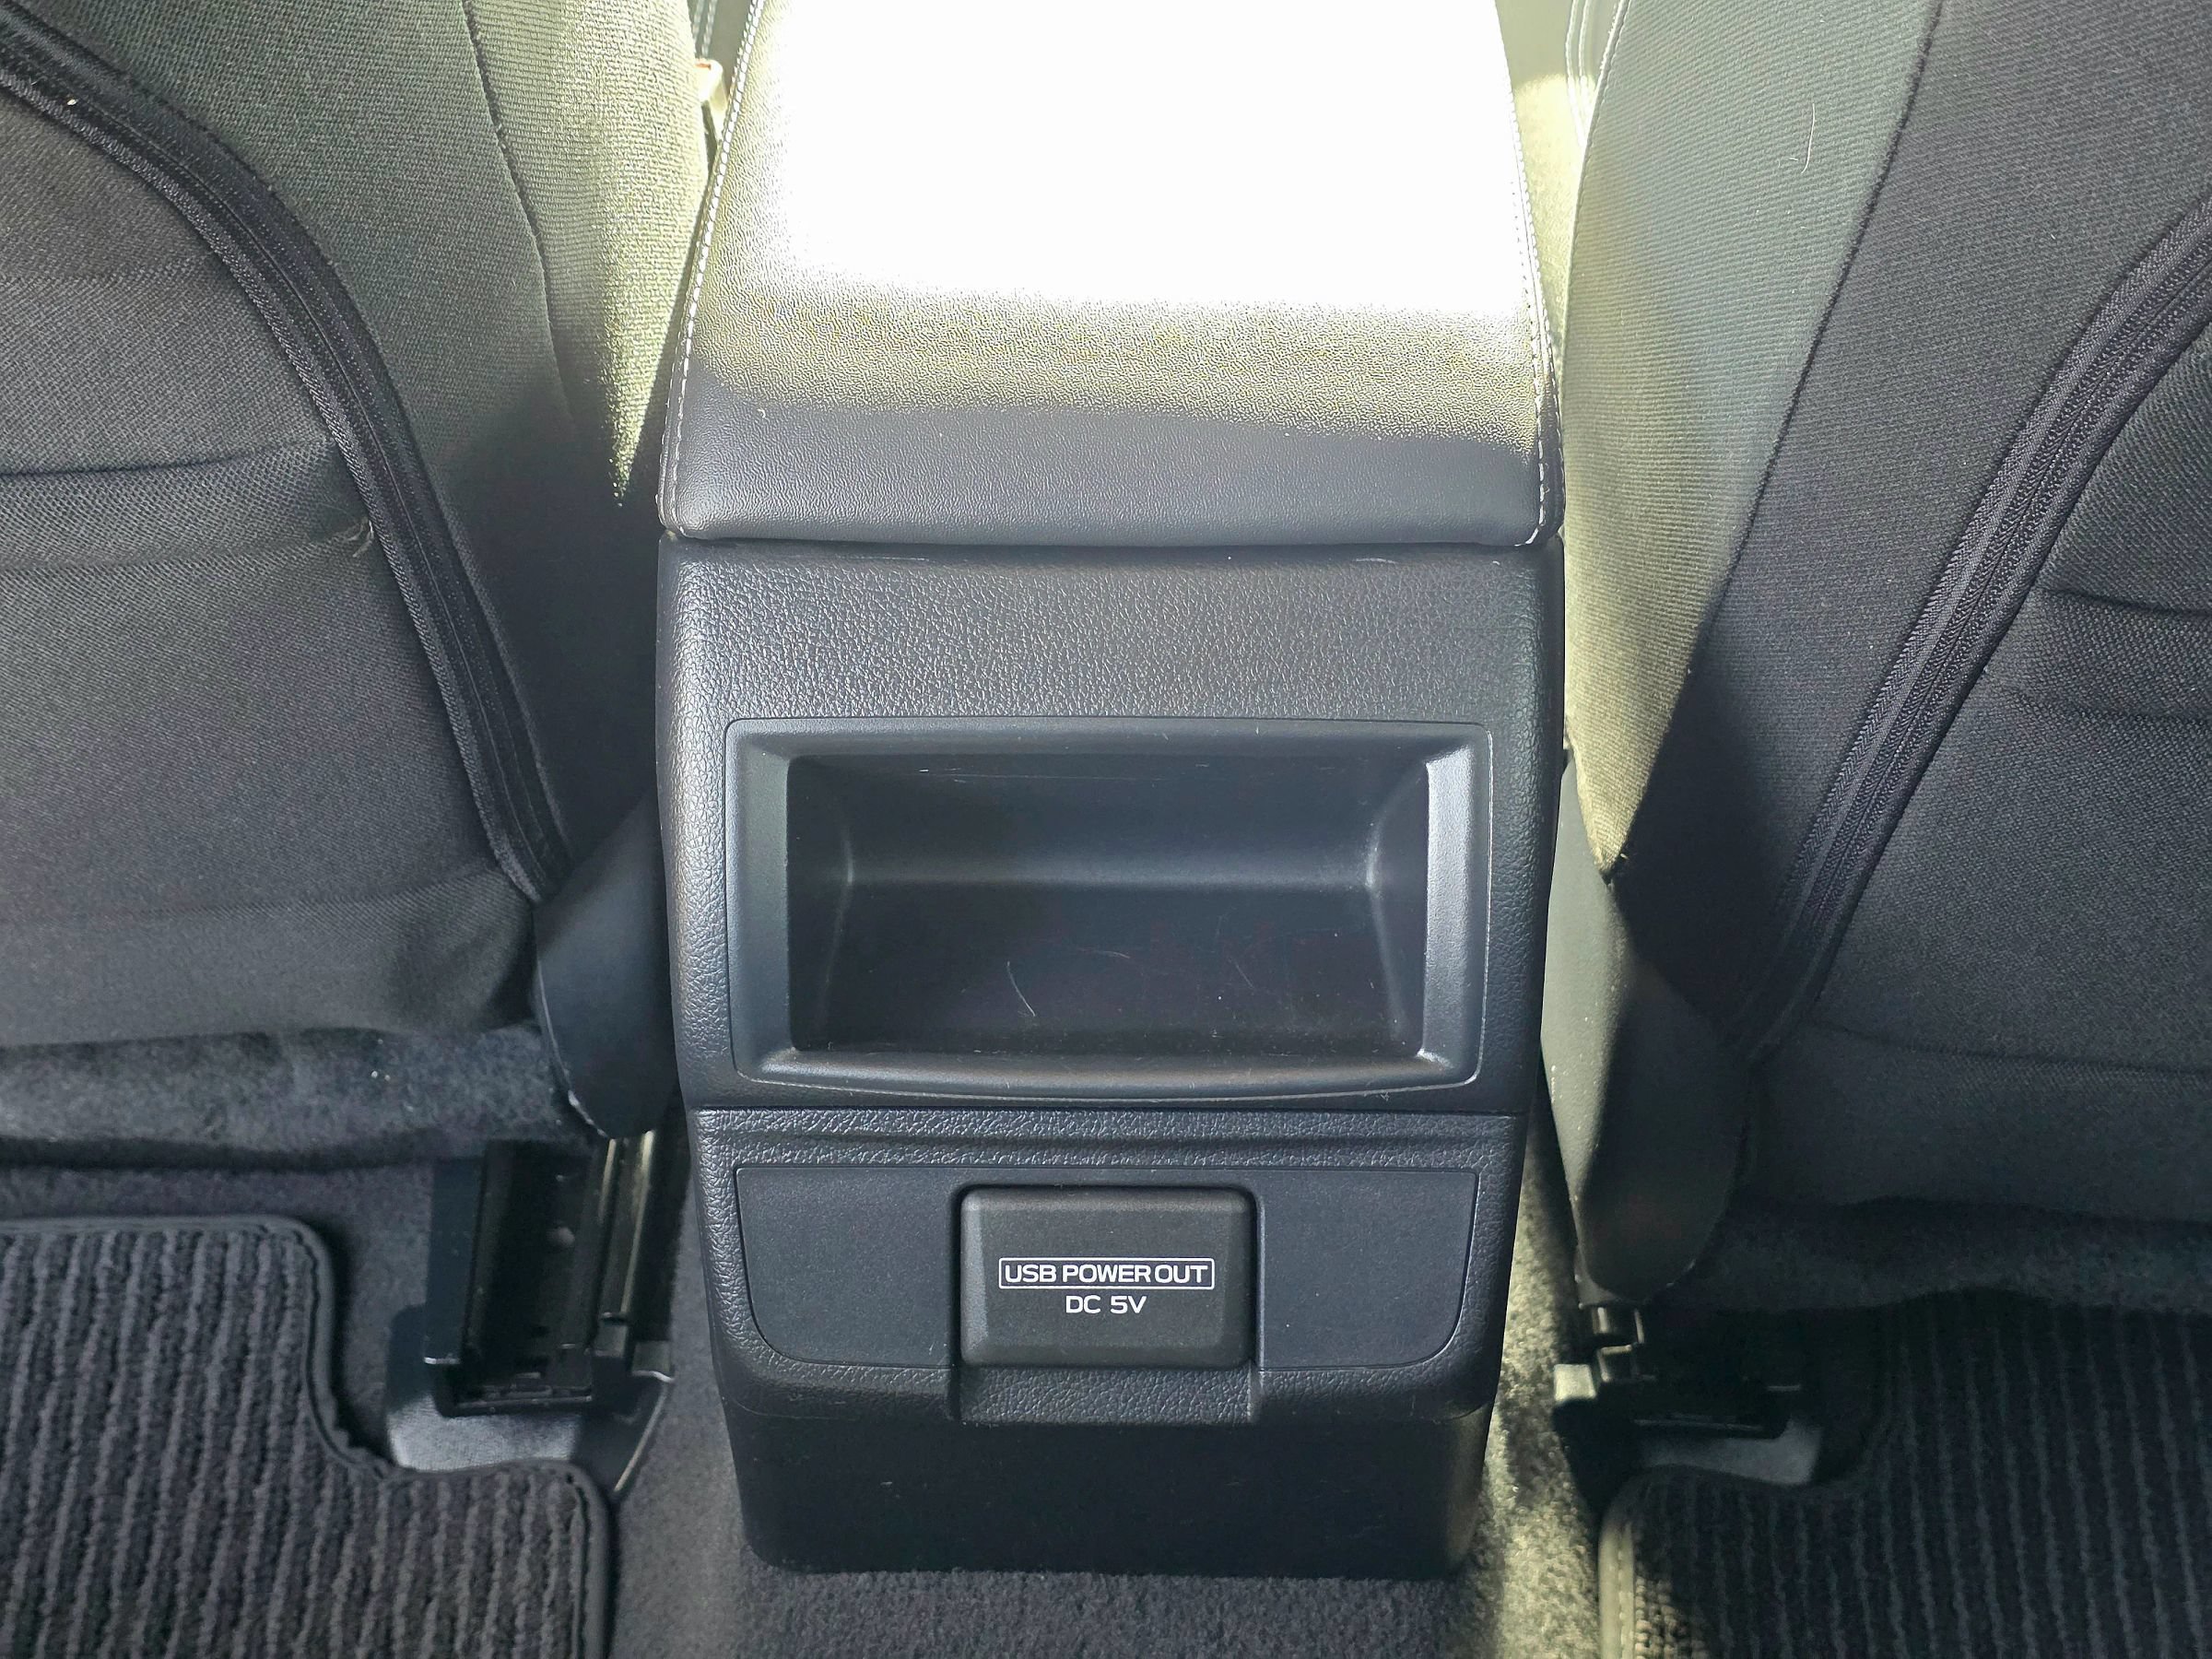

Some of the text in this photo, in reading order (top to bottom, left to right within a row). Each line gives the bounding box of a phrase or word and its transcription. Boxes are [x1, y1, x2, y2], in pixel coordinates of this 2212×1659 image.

[1005, 1264, 1208, 1284] USB POWER OUT
[1065, 1294, 1147, 1314] DC 5V
